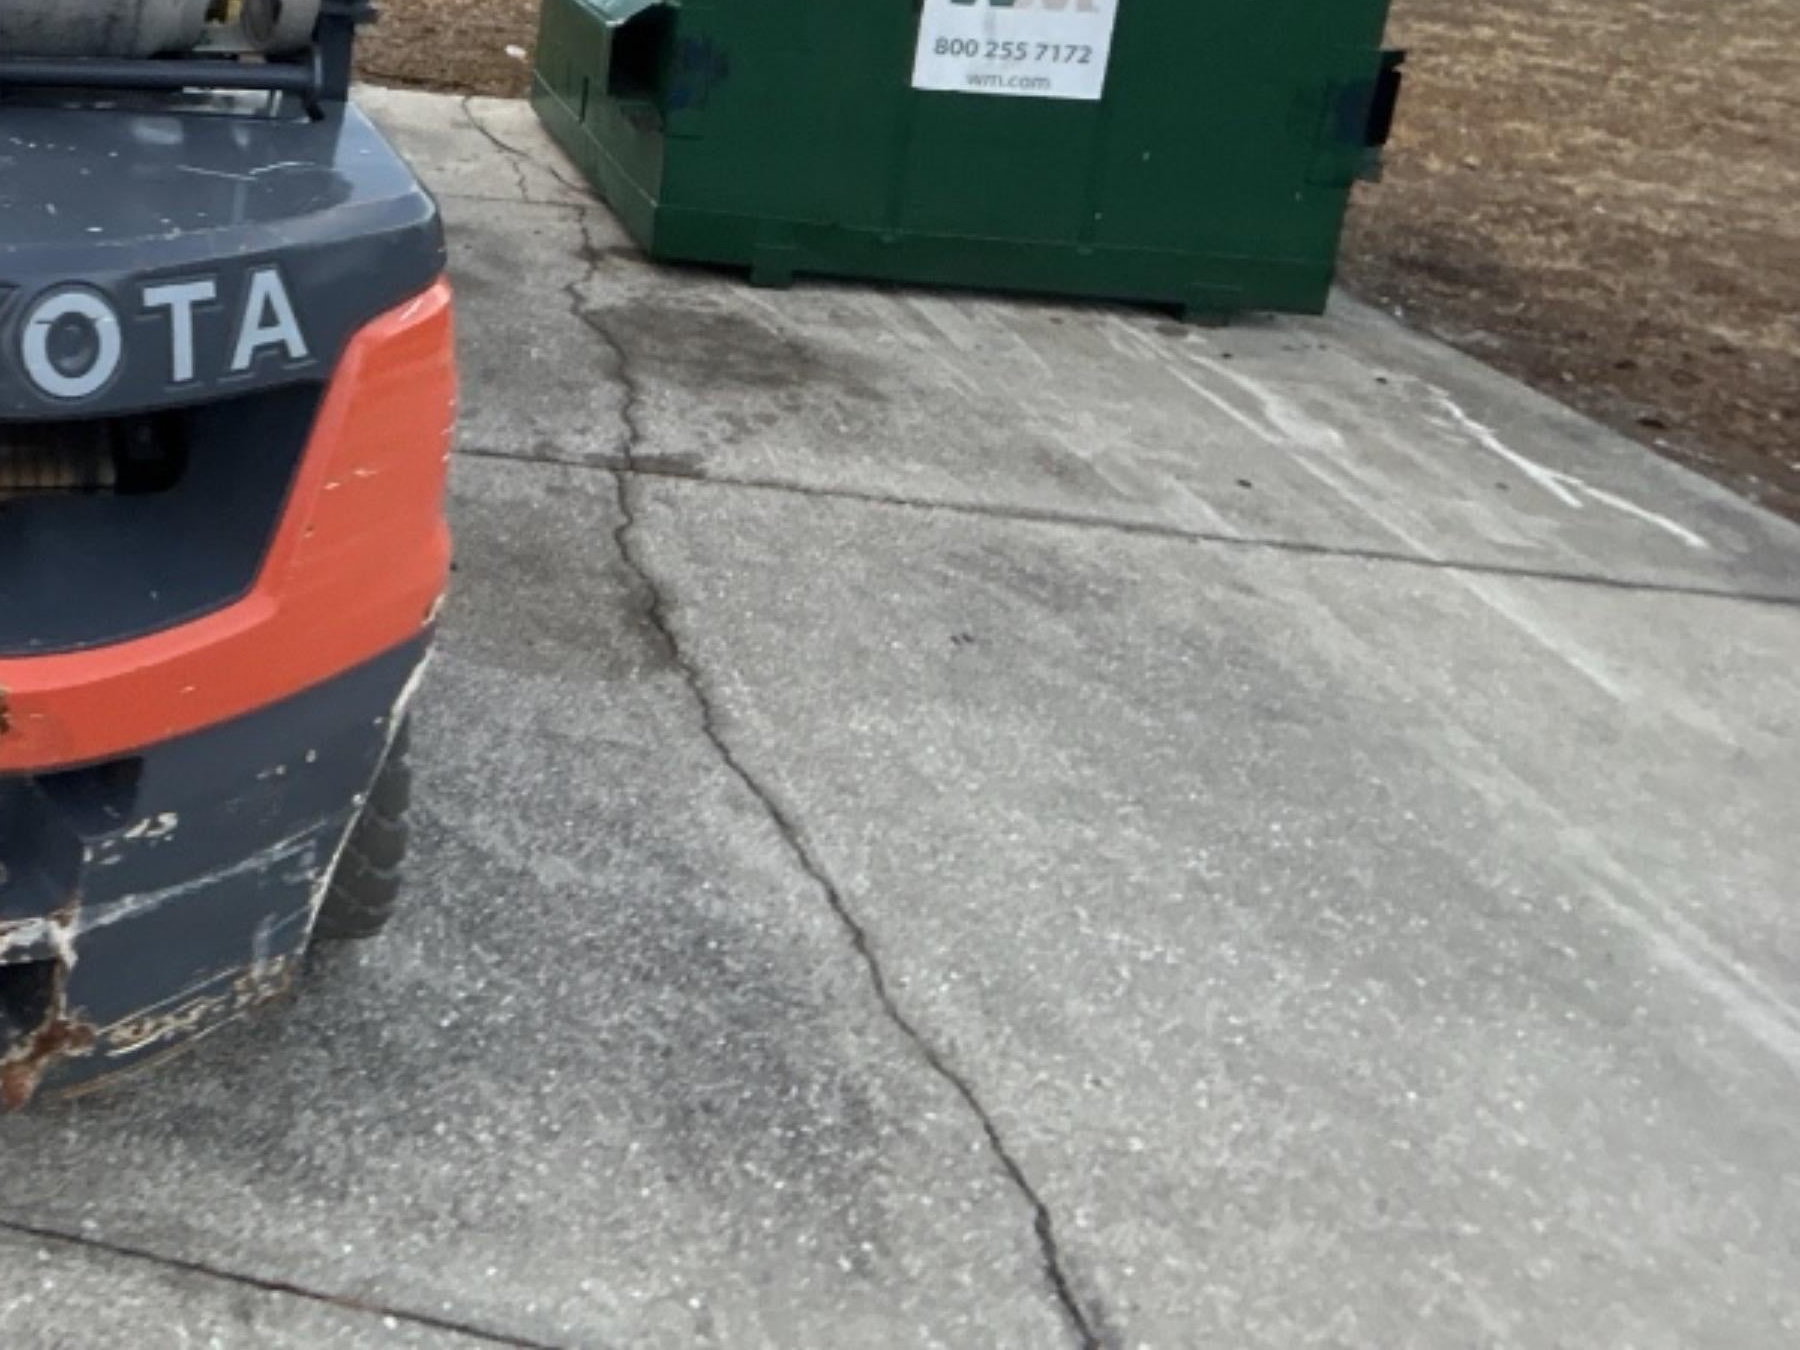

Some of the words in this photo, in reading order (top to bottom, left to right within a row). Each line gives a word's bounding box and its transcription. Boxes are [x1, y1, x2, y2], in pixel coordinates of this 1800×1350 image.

[934, 38, 979, 58] 800
[983, 41, 1028, 61] 255
[1034, 44, 1093, 64] 7172
[966, 73, 1052, 91] wm.com
